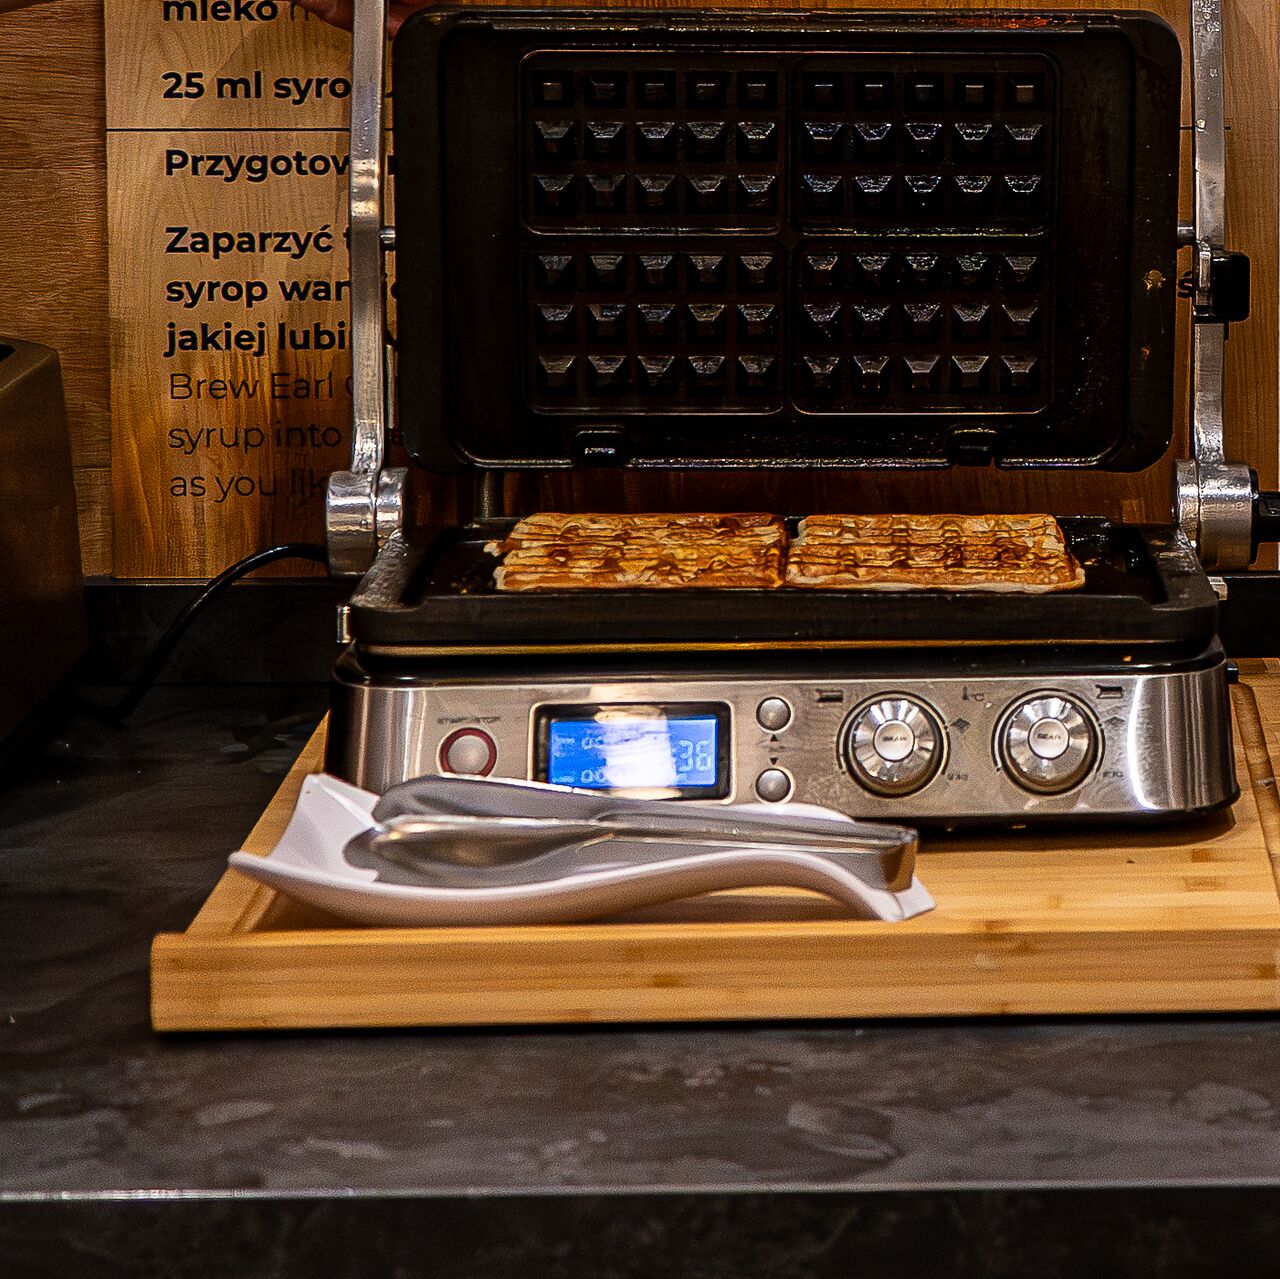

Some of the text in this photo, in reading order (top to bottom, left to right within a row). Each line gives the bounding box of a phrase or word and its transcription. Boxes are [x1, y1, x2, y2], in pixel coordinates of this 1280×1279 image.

[163, 71, 352, 105] 25 ml syro
[166, 225, 332, 259] Zaparzyć
[167, 282, 267, 308] syrop
[164, 321, 345, 357] jakiej lubi
[170, 373, 258, 401] Brew
[270, 371, 333, 400] Earl
[168, 421, 342, 453] syrup into
[170, 474, 207, 497] as
[213, 474, 276, 502] you
